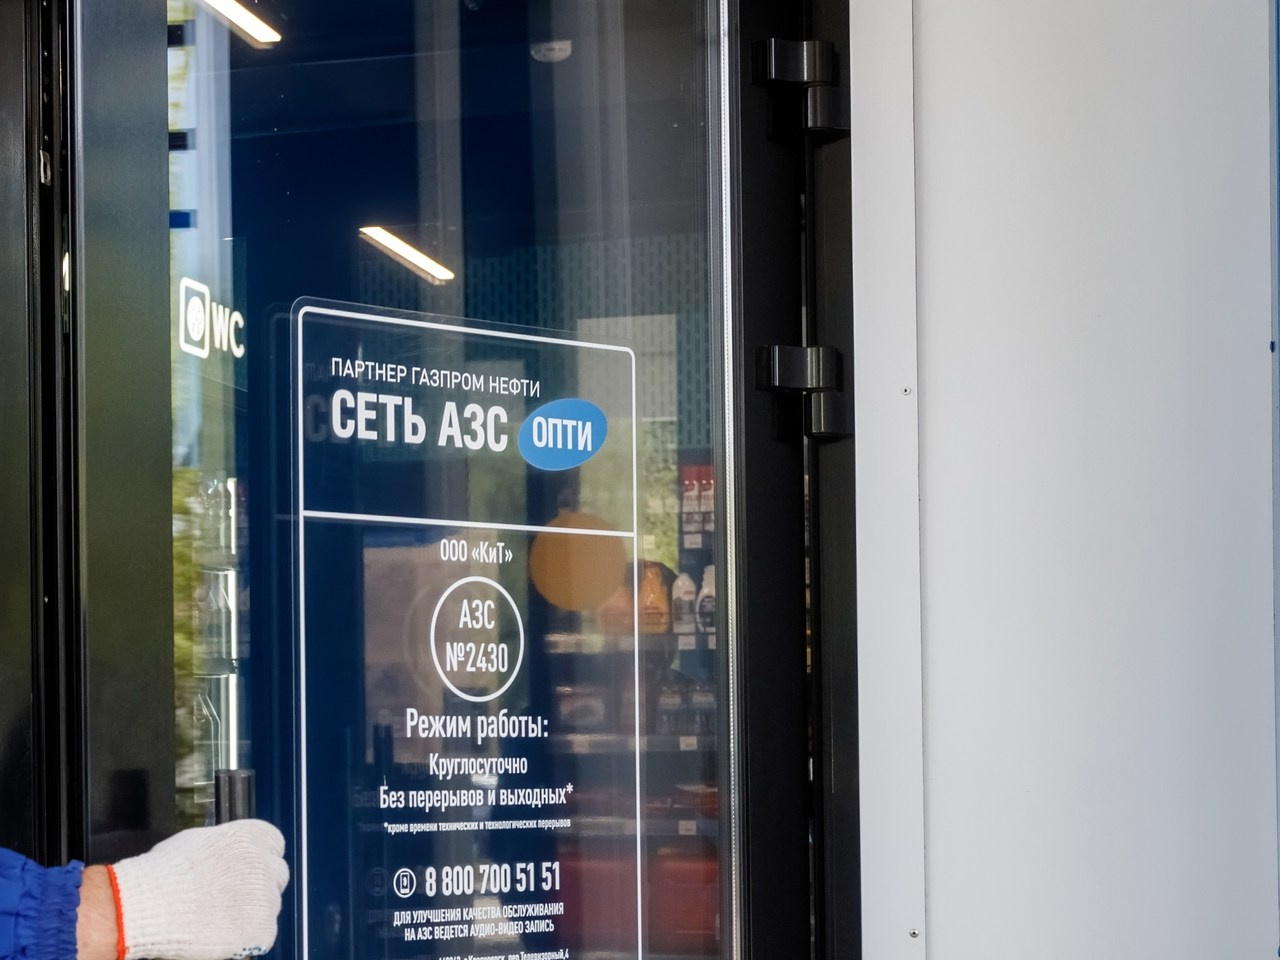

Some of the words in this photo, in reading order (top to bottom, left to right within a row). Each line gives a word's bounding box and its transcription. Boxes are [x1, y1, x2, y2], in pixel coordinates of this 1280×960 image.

[211, 301, 245, 358] WC
[331, 357, 407, 383] ПАРТНЕР
[412, 367, 484, 393] ГАЗПРОМ
[489, 376, 540, 398] НЕФТИ
[332, 389, 426, 444] СЕТЬ
[438, 400, 508, 452] АЗС
[532, 416, 592, 452] ОПТИ
[440, 539, 468, 562] ООО
[472, 541, 513, 564] «КиТ»
[459, 599, 495, 629] АЗС
[446, 642, 508, 673] №2430
[406, 708, 471, 738] Режим
[477, 709, 548, 745] работы:
[429, 753, 528, 780] Круглосуточно
[380, 785, 405, 809] Без
[409, 788, 484, 812] перерывов
[488, 790, 496, 806] и
[410, 823, 437, 835] времени
[439, 821, 478, 832] технических
[485, 819, 537, 830] технологических
[538, 819, 571, 830] перерывов
[425, 866, 437, 897] 8
[442, 865, 474, 895] 800
[479, 863, 511, 894] 700
[516, 862, 535, 892] 51
[541, 861, 560, 891] 51
[393, 911, 411, 927] ДЛЯ
[412, 908, 461, 924] УЛУЧШЕНИЯ
[463, 906, 501, 921] КАЧЕСТВА
[502, 902, 564, 918] ОБСЛУЖИВАНИЯ
[404, 927, 416, 941] НА
[417, 926, 433, 940] АЗС
[434, 924, 468, 940] ВЕДЕТСЯ
[469, 920, 523, 938] АУДИО-ВИДЕО
[525, 919, 554, 933] ЗАПИСЬ
